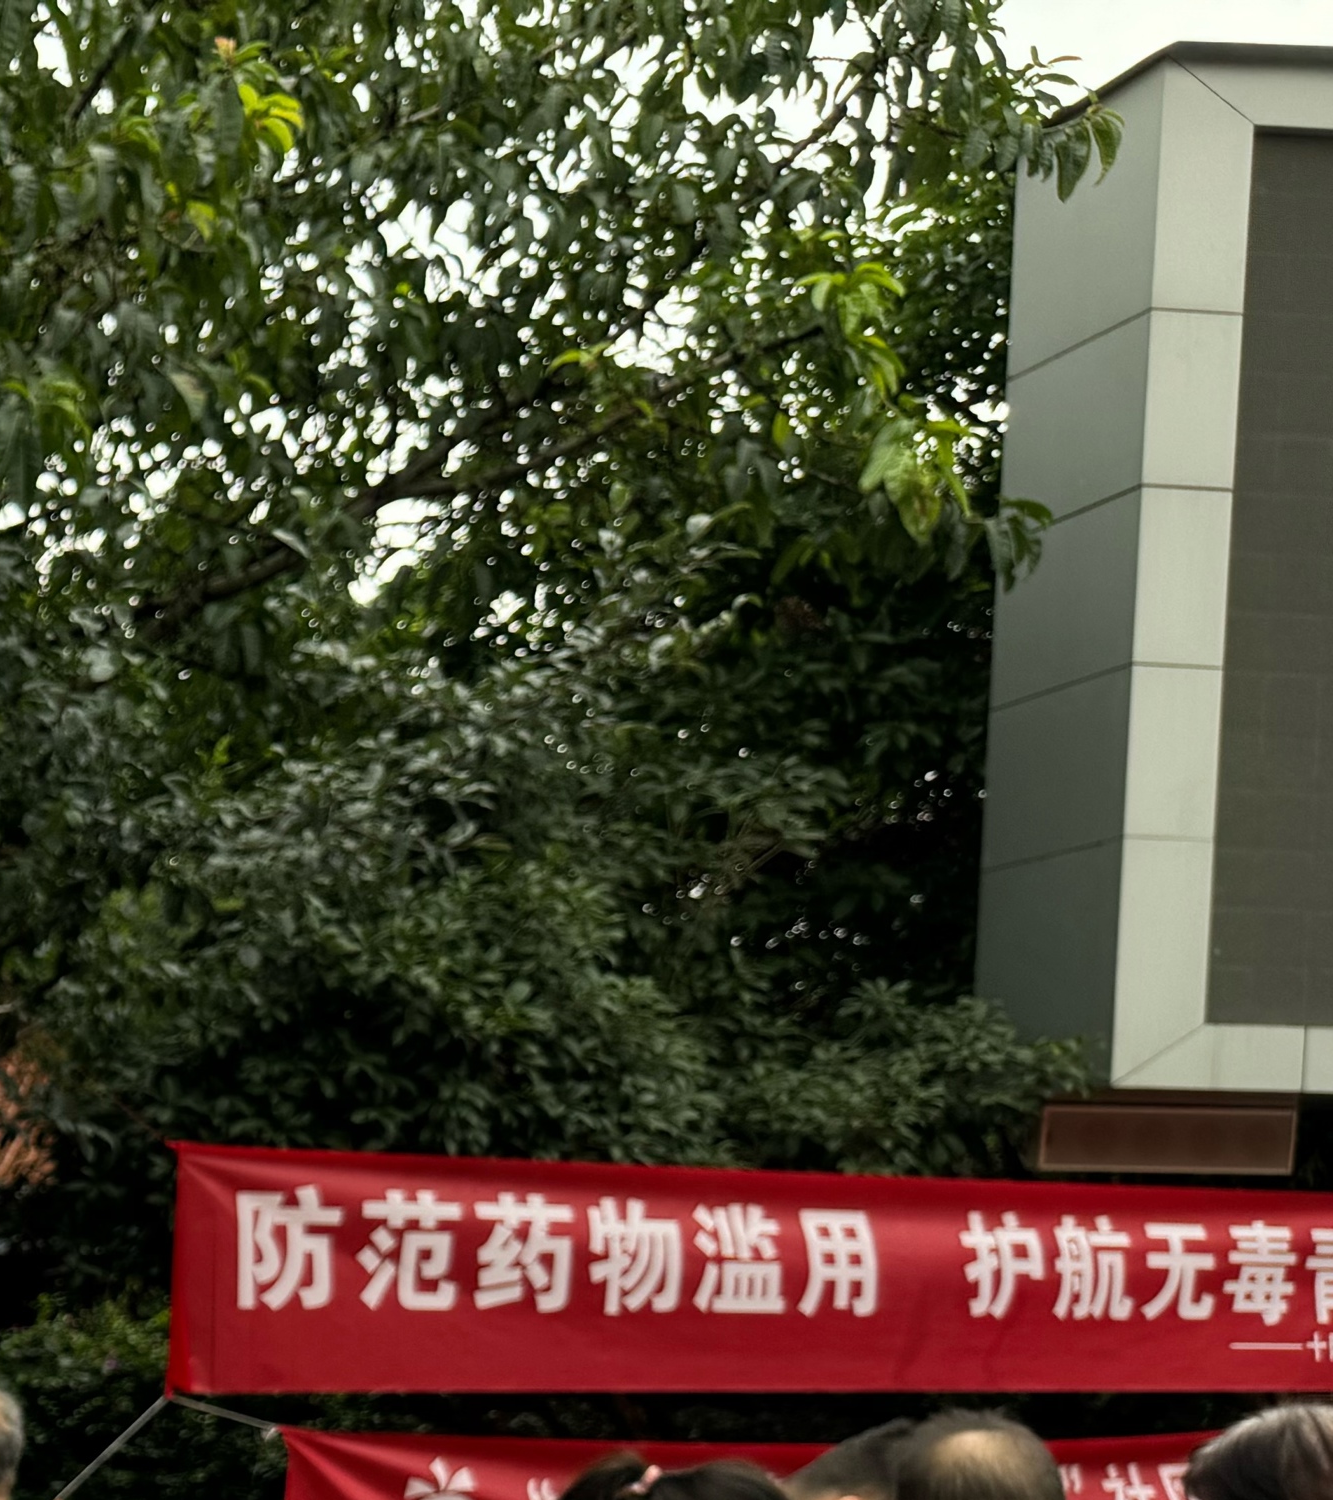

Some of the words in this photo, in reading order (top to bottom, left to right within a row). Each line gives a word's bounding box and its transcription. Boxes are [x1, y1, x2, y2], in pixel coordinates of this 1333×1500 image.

[235, 1184, 879, 1317] 防范药物滥用
